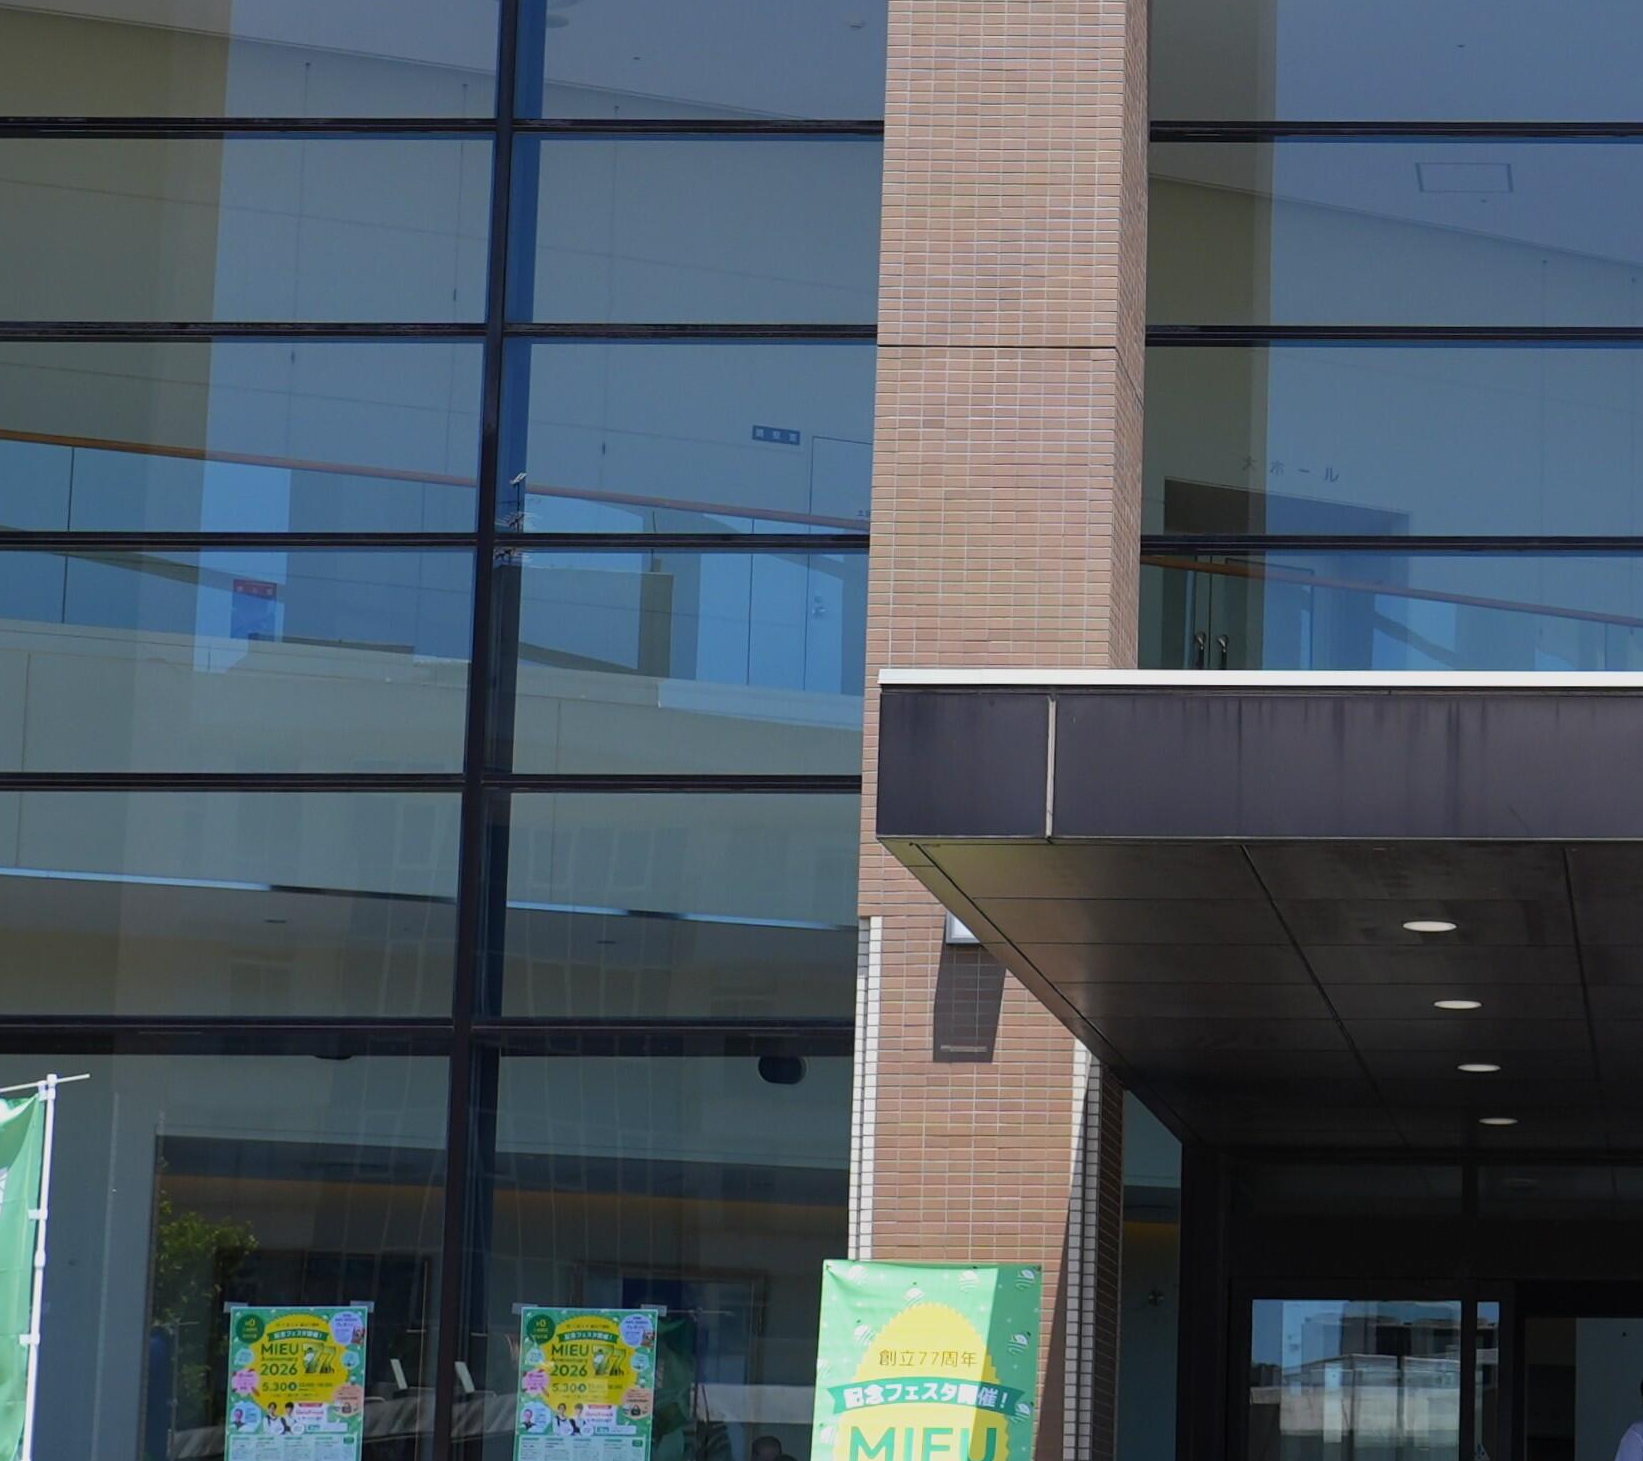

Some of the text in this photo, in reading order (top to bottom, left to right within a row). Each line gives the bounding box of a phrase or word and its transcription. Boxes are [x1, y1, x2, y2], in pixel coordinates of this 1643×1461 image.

[261, 1343, 299, 1355] MIEU
[551, 1344, 589, 1357] MIEU
[879, 1349, 978, 1368] 創立77周年
[260, 1363, 298, 1376] 2026
[550, 1364, 588, 1377] 2026
[843, 1382, 1009, 1409] 記念フェスタ開催!
